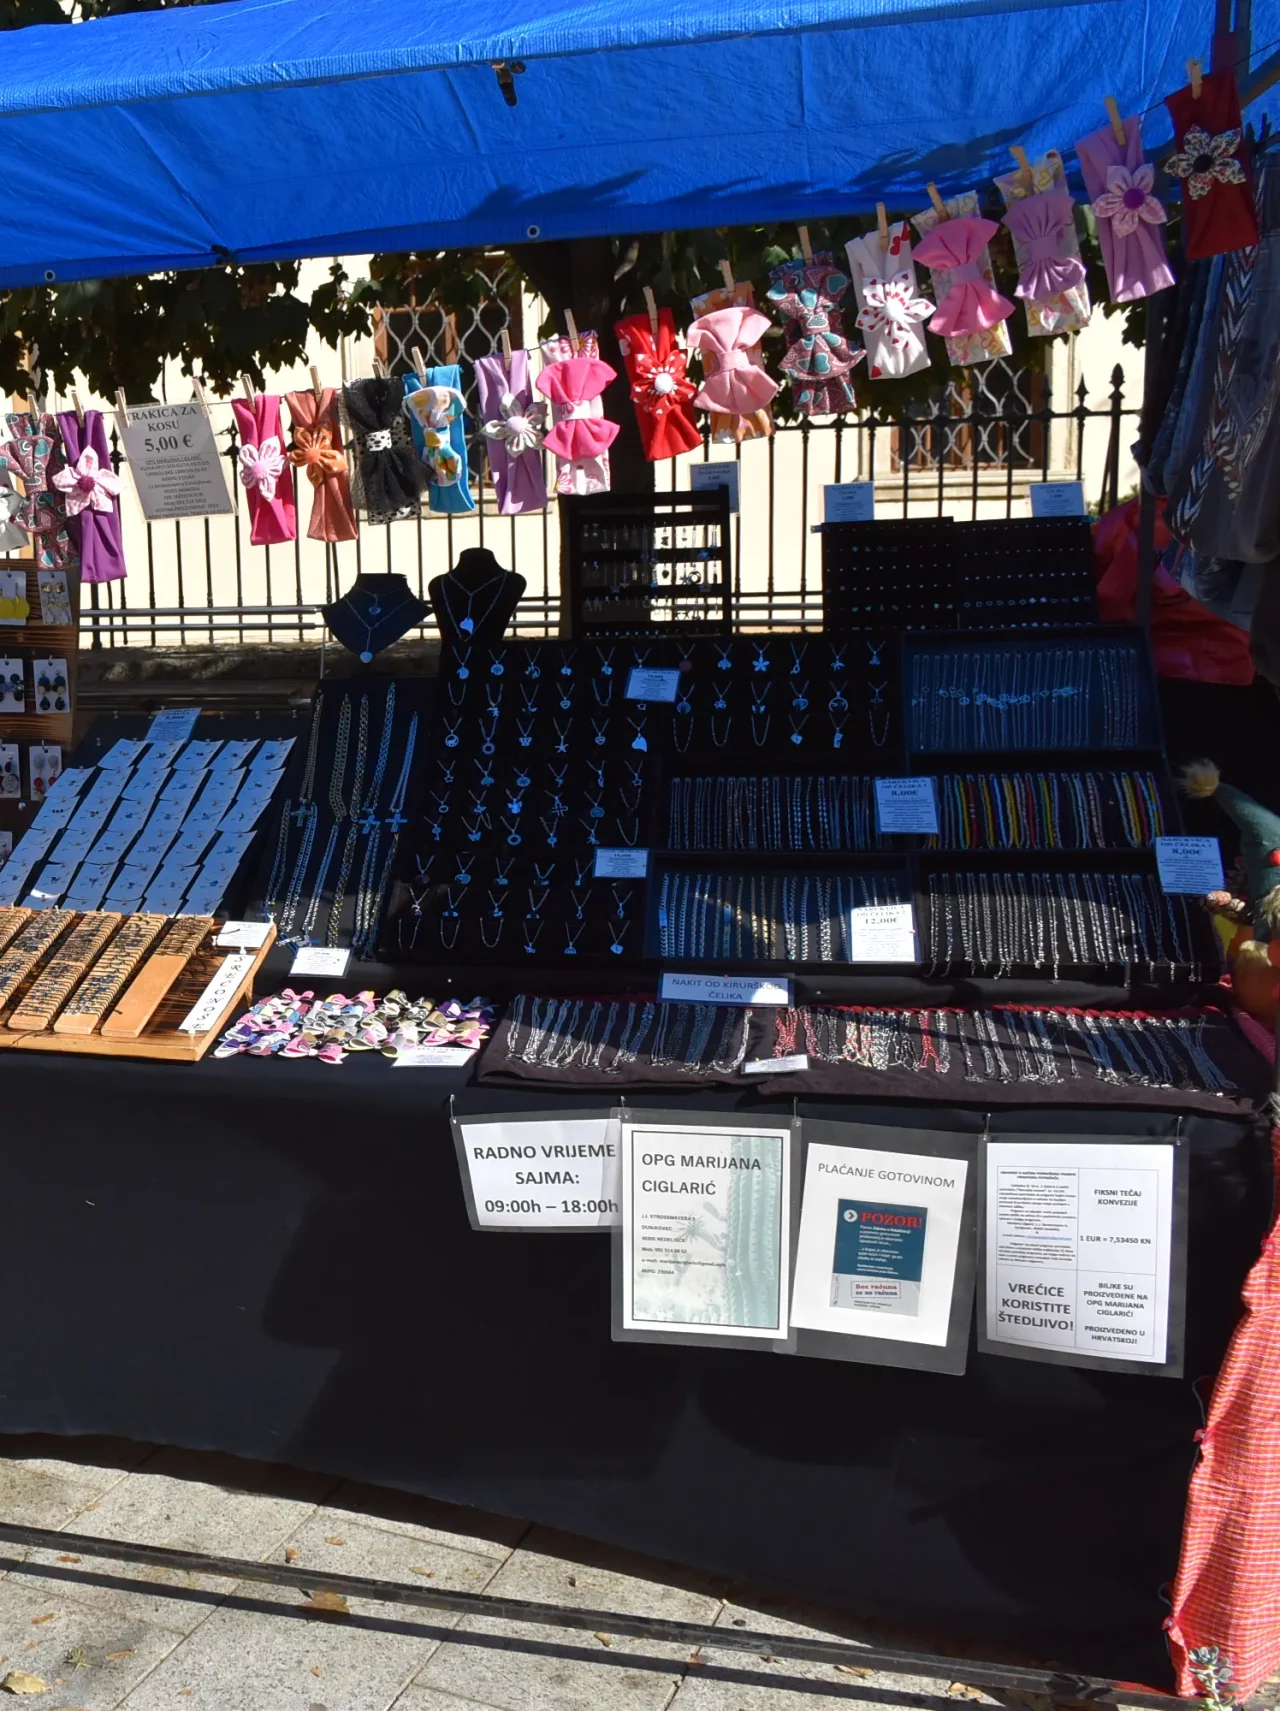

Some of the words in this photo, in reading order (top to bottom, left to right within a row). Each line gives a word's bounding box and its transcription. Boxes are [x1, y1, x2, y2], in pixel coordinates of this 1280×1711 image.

[126, 408, 178, 422] TRAKICA
[181, 406, 197, 416] ZA
[147, 420, 180, 432] KOSU
[144, 436, 178, 453] 5,00
[183, 434, 194, 448] €
[1172, 848, 1203, 856] 8,00€
[865, 917, 899, 925] 12,00€
[672, 978, 702, 987] NAKIT
[704, 980, 720, 988] OD
[723, 980, 782, 990] KIRURŠKOG
[708, 991, 743, 1000] ČELIKA
[473, 1145, 537, 1160] RADNO
[541, 1144, 617, 1158] VRIJEME
[642, 1153, 675, 1167] OPG
[681, 1155, 762, 1171] MARIJANA
[515, 1171, 580, 1185] SAJMA:
[818, 1163, 875, 1178] PLAĆANJE
[878, 1170, 955, 1188] GOTOVINOM
[642, 1179, 717, 1196] CIGLARIĆ
[1119, 1189, 1142, 1197] TEČAJ
[484, 1199, 541, 1213] 09:00h
[561, 1199, 619, 1214] 18:00h
[1097, 1198, 1138, 1207] KONVEZIJE
[860, 1211, 923, 1229] POZOR!
[1109, 1236, 1139, 1244] 7,53450
[1008, 1282, 1065, 1297] VREĆICE
[1123, 1283, 1134, 1291] SU
[1083, 1290, 1135, 1300] PROIZVEDENE
[1002, 1298, 1071, 1314] KORISTITE
[1086, 1299, 1103, 1307] OPG
[1104, 1301, 1145, 1309] MARIJANA
[998, 1311, 1074, 1331] ŠTEDLJIVO!
[1084, 1325, 1138, 1336] PROIZVEDENO
[1091, 1334, 1138, 1345] HRVATSKOJ!
